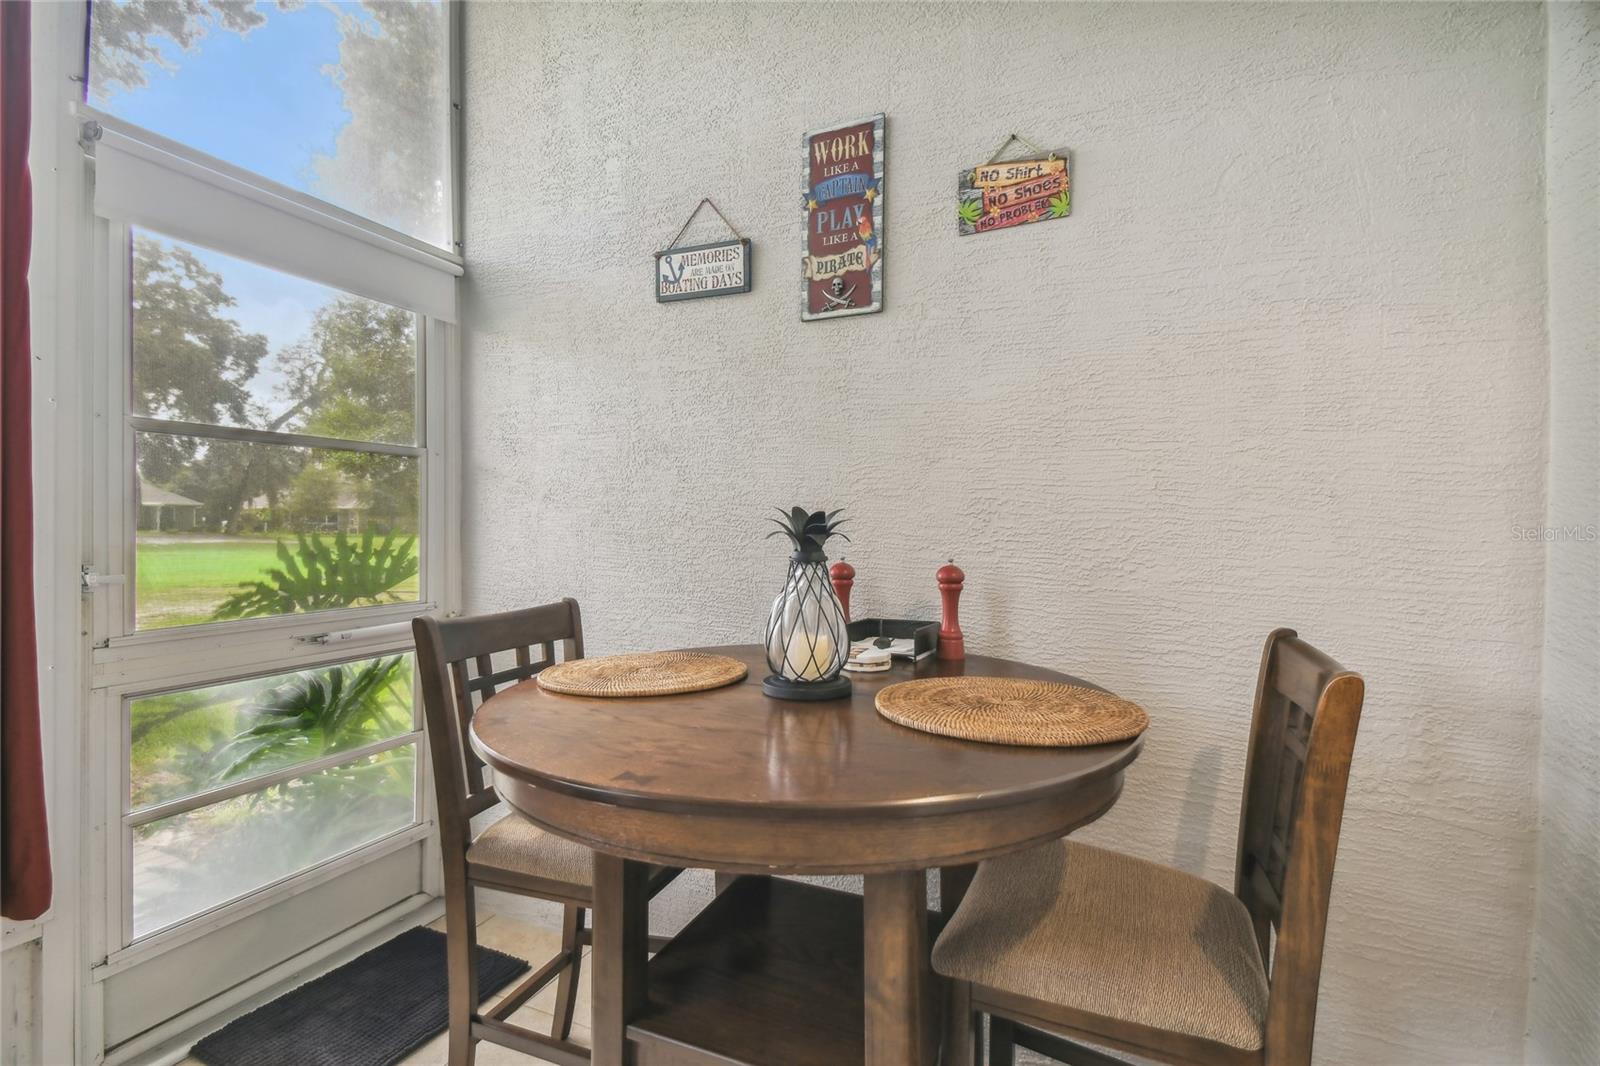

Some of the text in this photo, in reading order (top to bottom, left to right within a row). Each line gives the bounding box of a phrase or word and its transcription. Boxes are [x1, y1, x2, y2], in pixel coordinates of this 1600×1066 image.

[814, 129, 871, 165] WORK
[824, 161, 860, 177] LIKE A
[980, 168, 1000, 182] NO
[988, 192, 1008, 207] NO
[816, 203, 865, 234] PLAY
[980, 216, 995, 230] NO
[823, 231, 858, 246] LIKE A
[681, 246, 740, 267] MEMORIES
[815, 251, 865, 274] PIRATE
[690, 264, 735, 277] ARE MADE ON
[661, 271, 743, 294] BOATING DAYS
